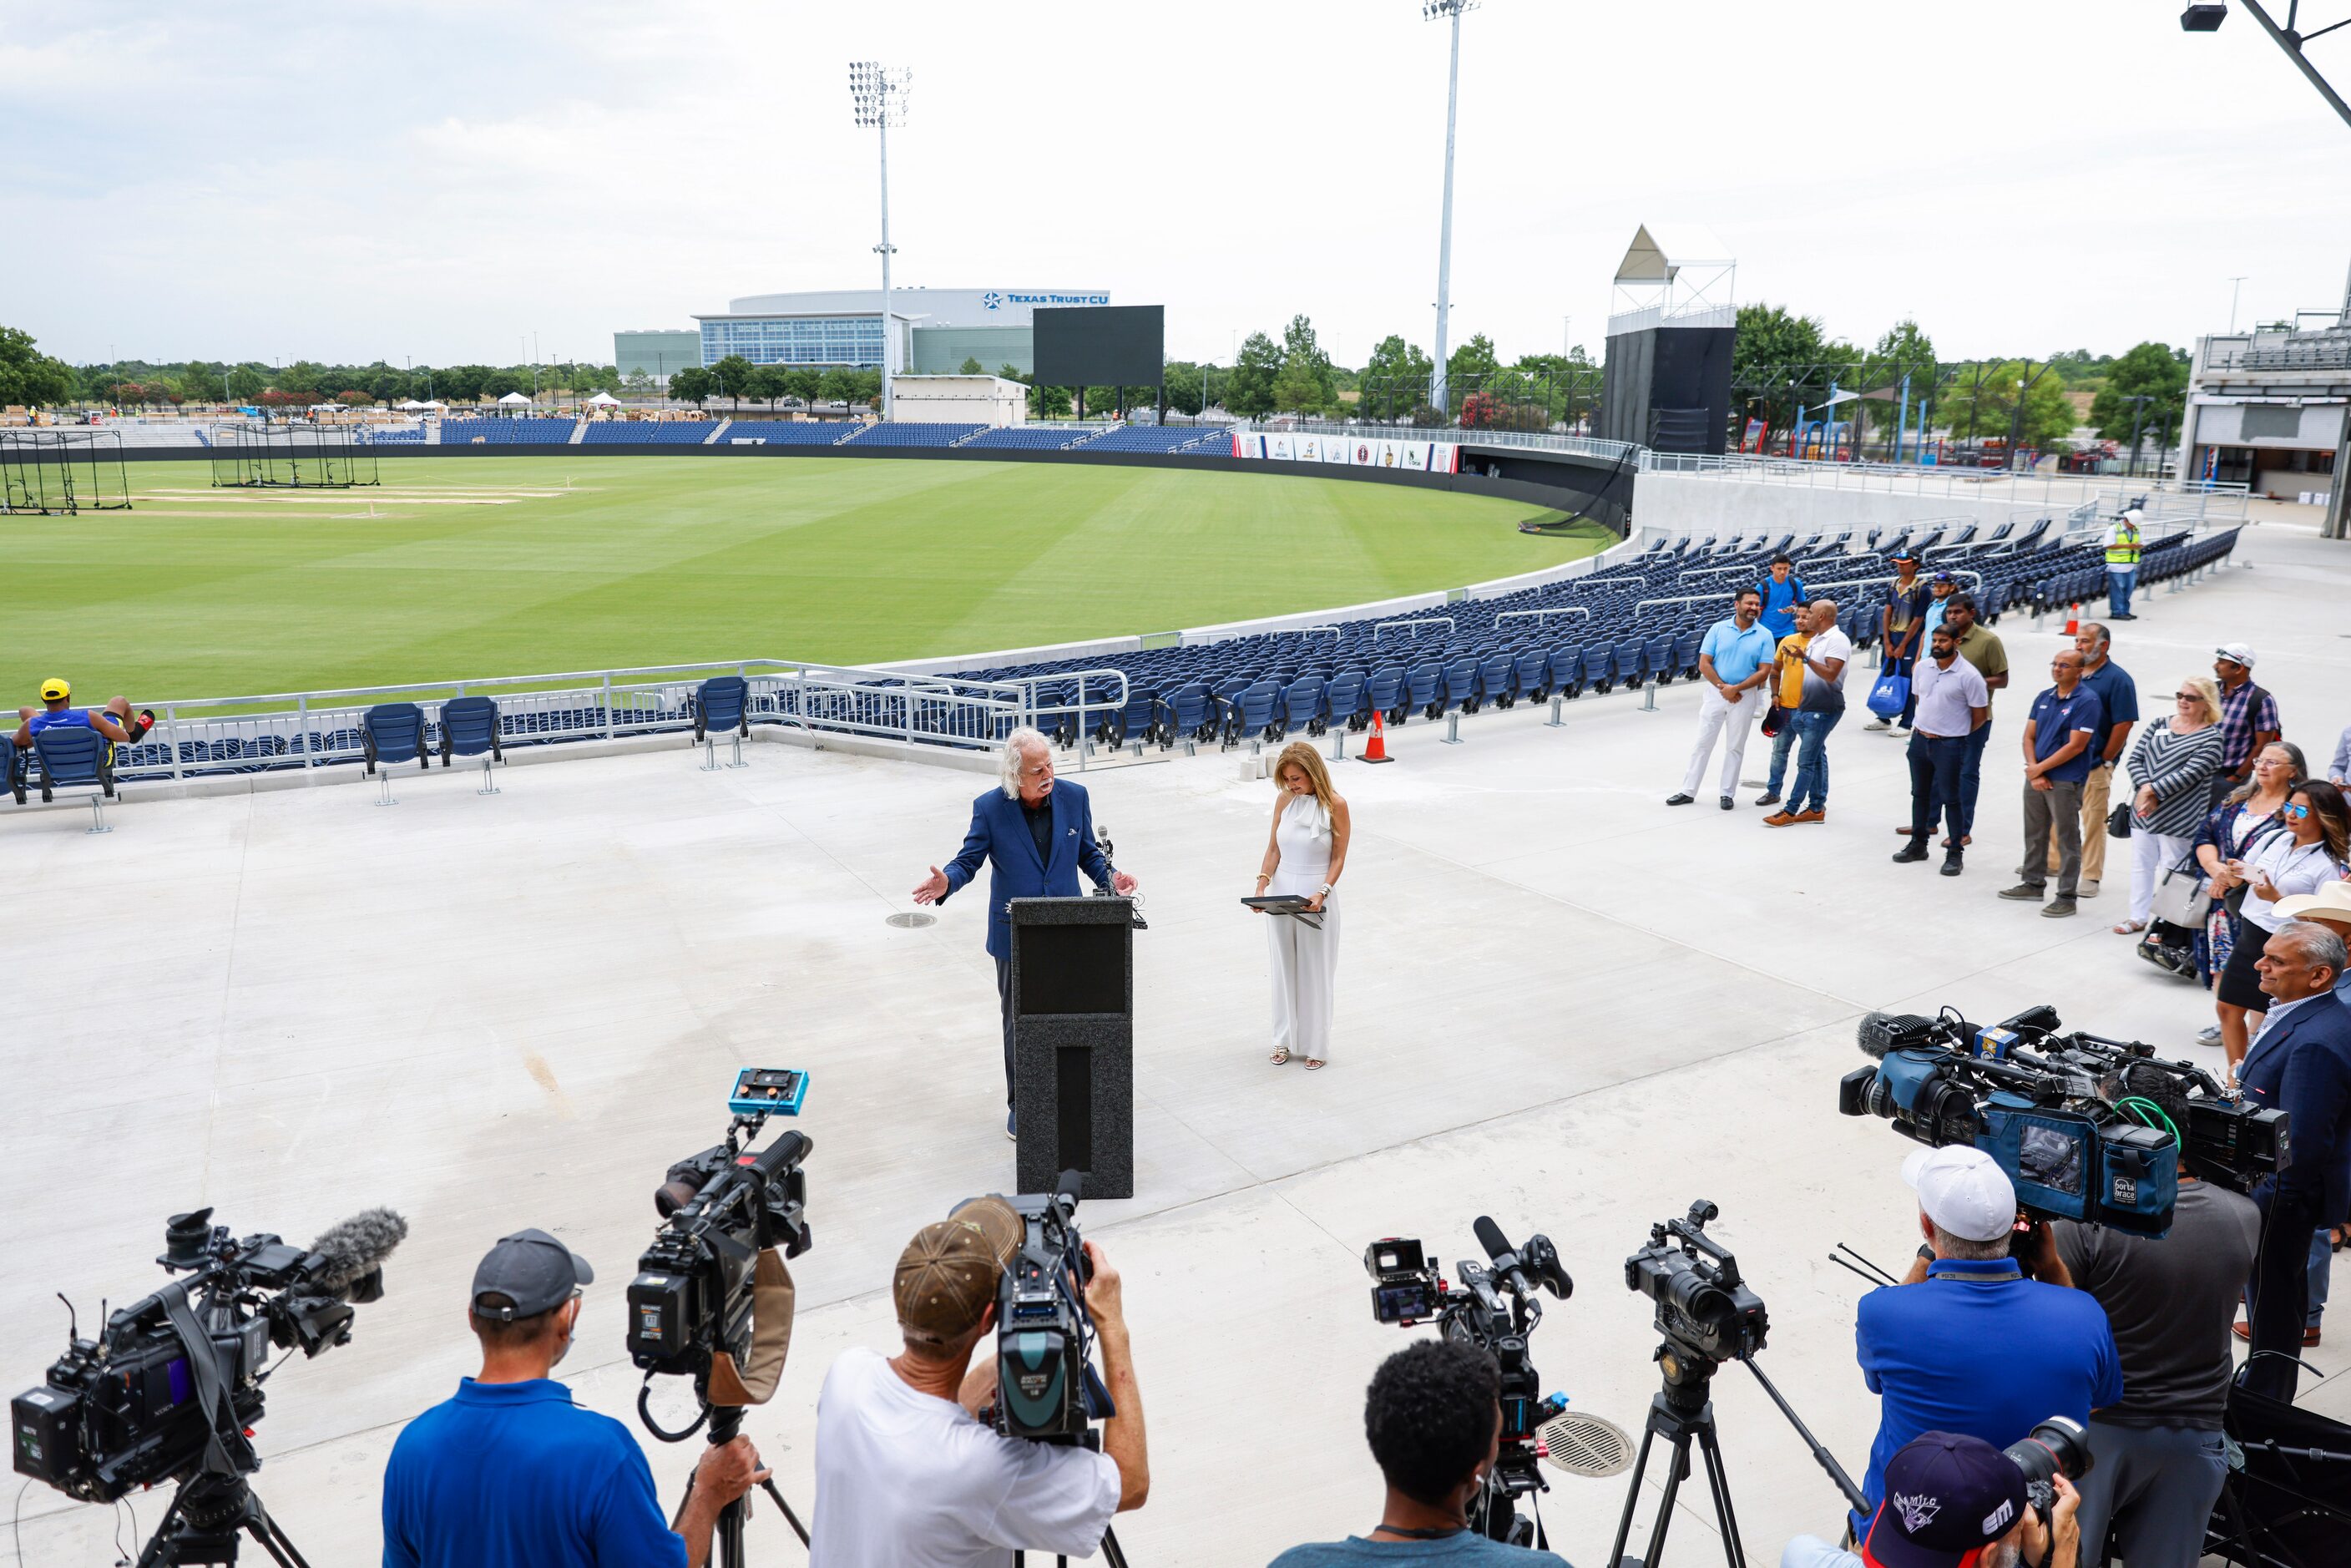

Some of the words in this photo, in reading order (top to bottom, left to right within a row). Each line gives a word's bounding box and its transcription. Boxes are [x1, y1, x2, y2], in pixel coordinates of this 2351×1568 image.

[1008, 294, 1047, 303] TEXAS
[1049, 295, 1088, 304] TRUST
[1090, 296, 1109, 305] CU
[2115, 1179, 2135, 1191] porta
